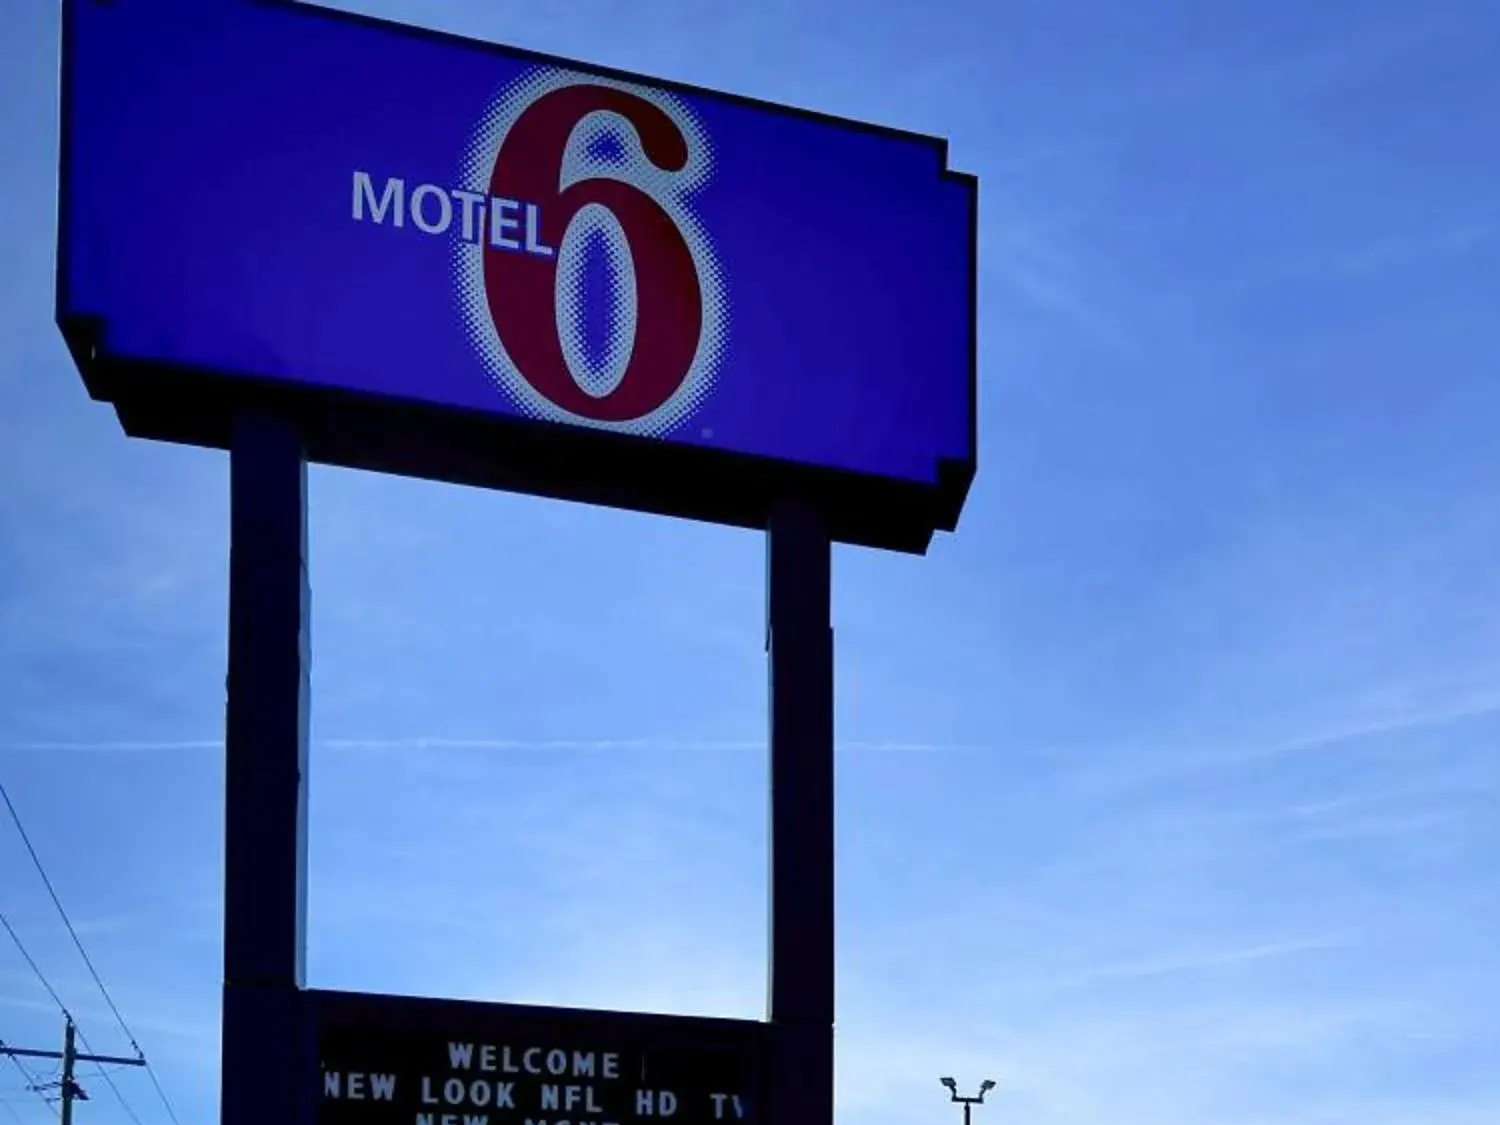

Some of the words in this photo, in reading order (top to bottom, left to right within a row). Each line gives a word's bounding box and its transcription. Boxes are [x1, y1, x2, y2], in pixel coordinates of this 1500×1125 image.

[352, 171, 554, 256] MOTEL
[479, 80, 707, 428] 6
[448, 1042, 620, 1078] WELCOME
[323, 1072, 396, 1100] NEW
[421, 1077, 516, 1109] LOOK
[540, 1084, 602, 1113] NFL
[635, 1089, 677, 1116] HD
